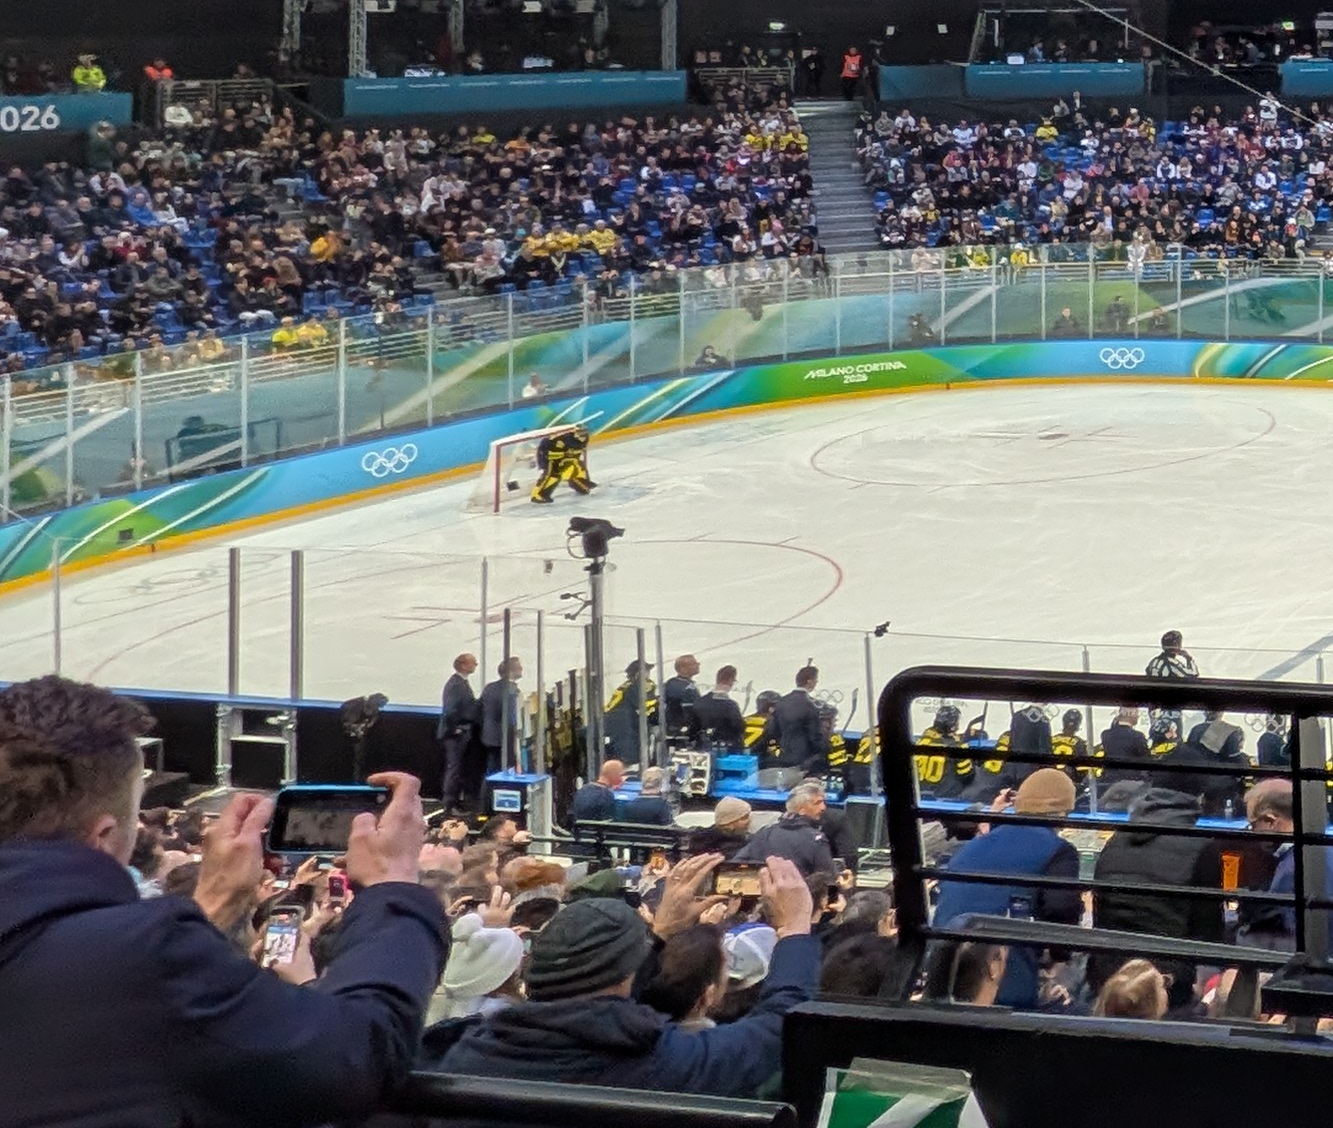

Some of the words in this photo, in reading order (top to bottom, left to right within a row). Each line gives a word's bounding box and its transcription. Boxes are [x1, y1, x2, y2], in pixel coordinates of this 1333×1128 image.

[0, 105, 61, 132] 026
[804, 366, 854, 379] MILANO
[856, 361, 907, 373] CORTINA
